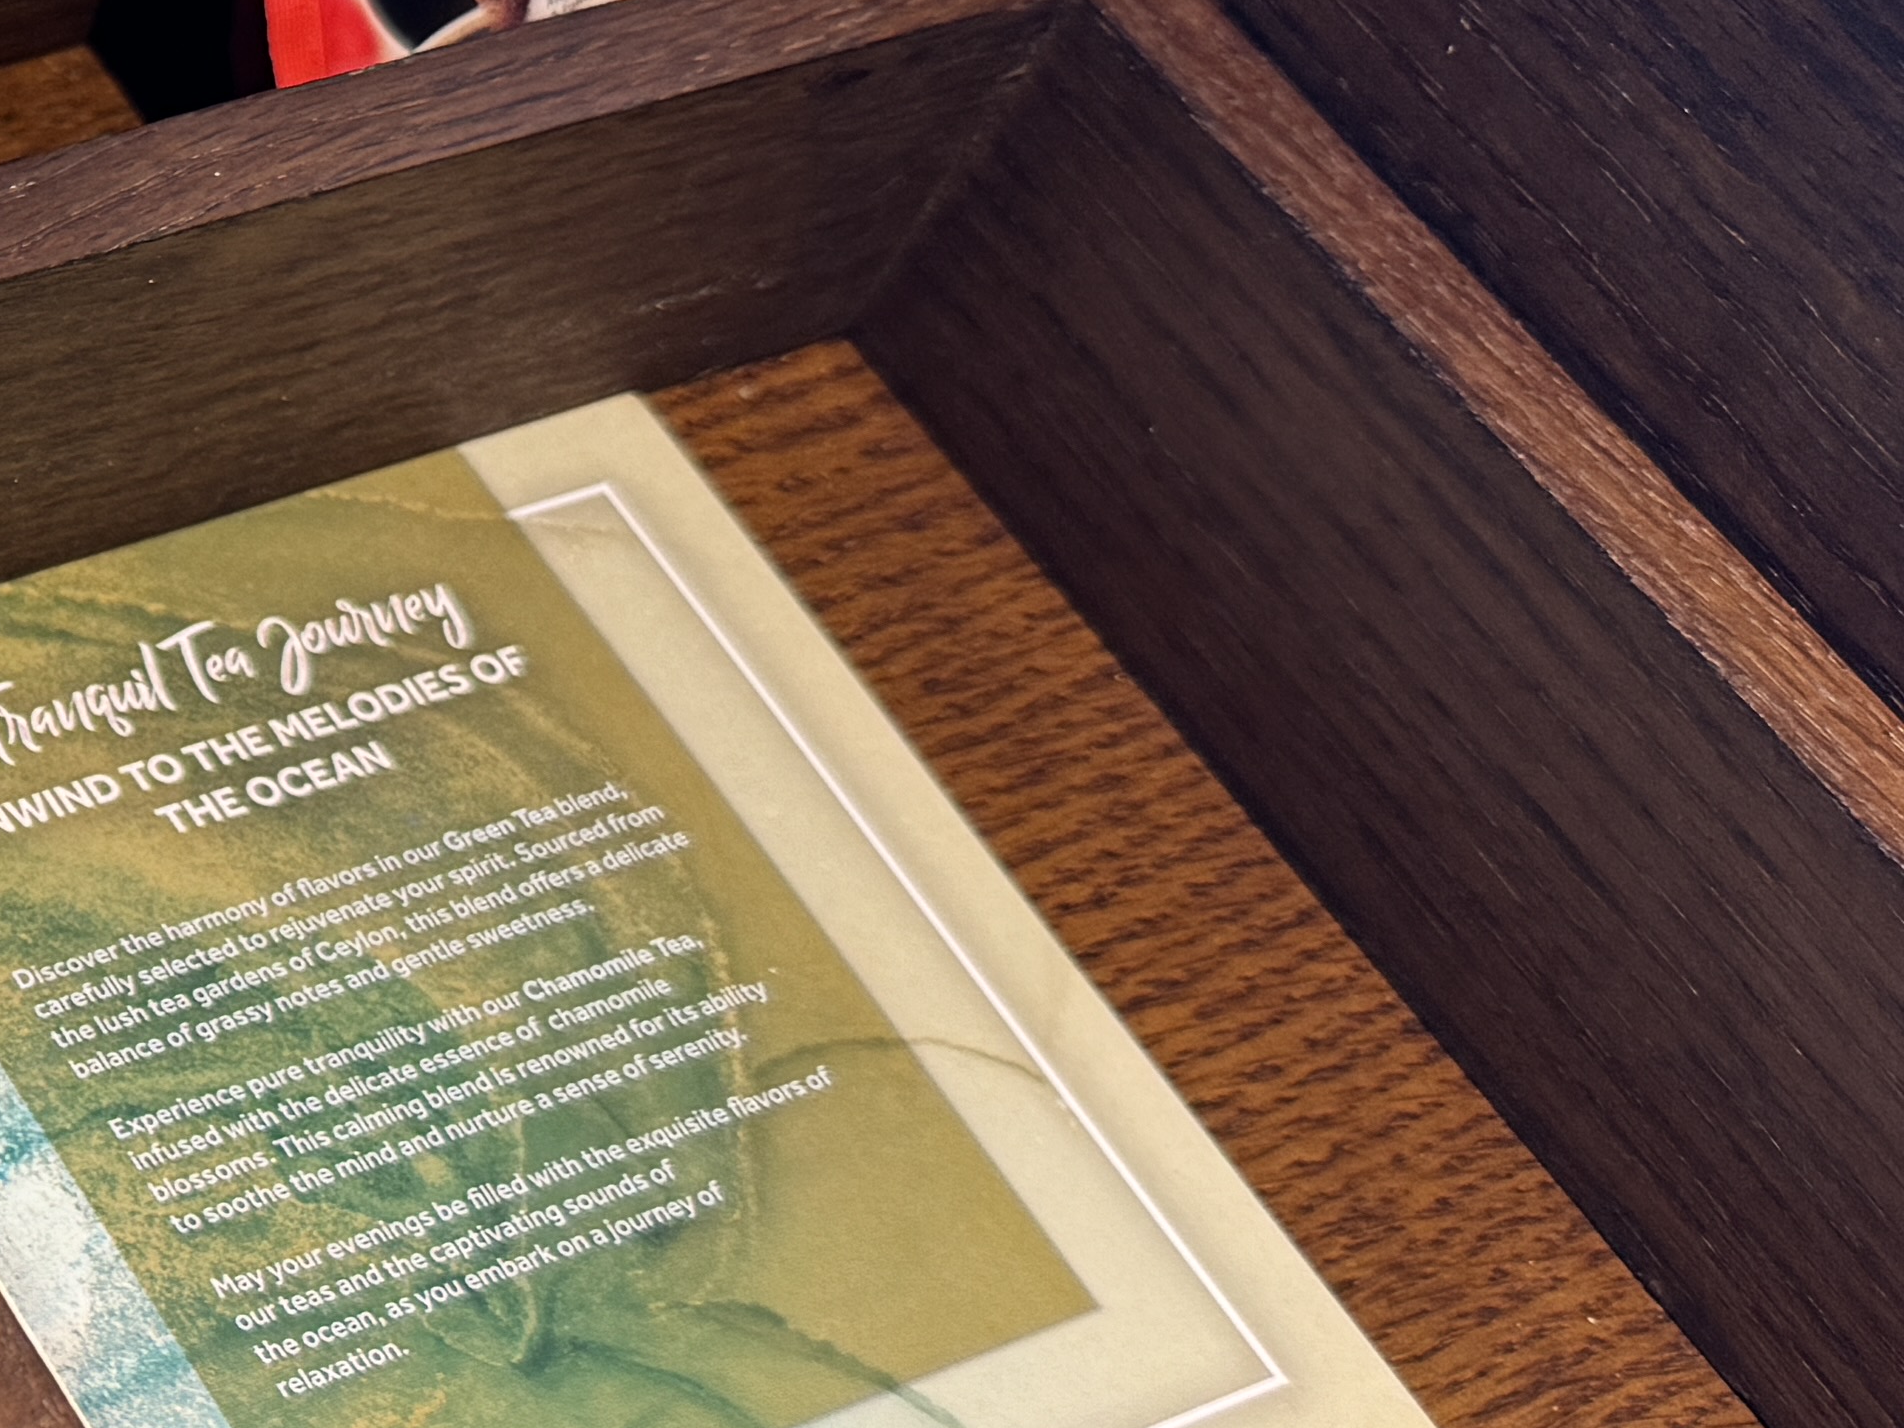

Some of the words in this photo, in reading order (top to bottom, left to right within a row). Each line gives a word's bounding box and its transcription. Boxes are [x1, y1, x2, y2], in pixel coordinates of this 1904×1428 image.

[116, 752, 187, 793] TO
[179, 723, 276, 773] THE
[266, 663, 476, 748] MELODIES
[469, 643, 529, 686] OF
[154, 619, 260, 705] Tea
[254, 582, 475, 697] Journey
[152, 785, 252, 834] THE
[244, 739, 399, 808] OCEAN
[66, 1037, 168, 1082] balance
[165, 1020, 196, 1049] of
[194, 1000, 276, 1044] grassy
[272, 978, 347, 1014] notes
[343, 958, 393, 991] and
[390, 938, 468, 981] gentle
[465, 898, 596, 951] sweetness.
[251, 1336, 303, 1369] the
[300, 1310, 389, 1350] ocean,
[383, 1296, 418, 1321] as
[412, 1278, 468, 1315] you
[463, 1243, 561, 1293] embark
[555, 1234, 593, 1259] on
[588, 1227, 611, 1247] a
[601, 1194, 698, 1247] journey
[695, 1178, 726, 1208] of
